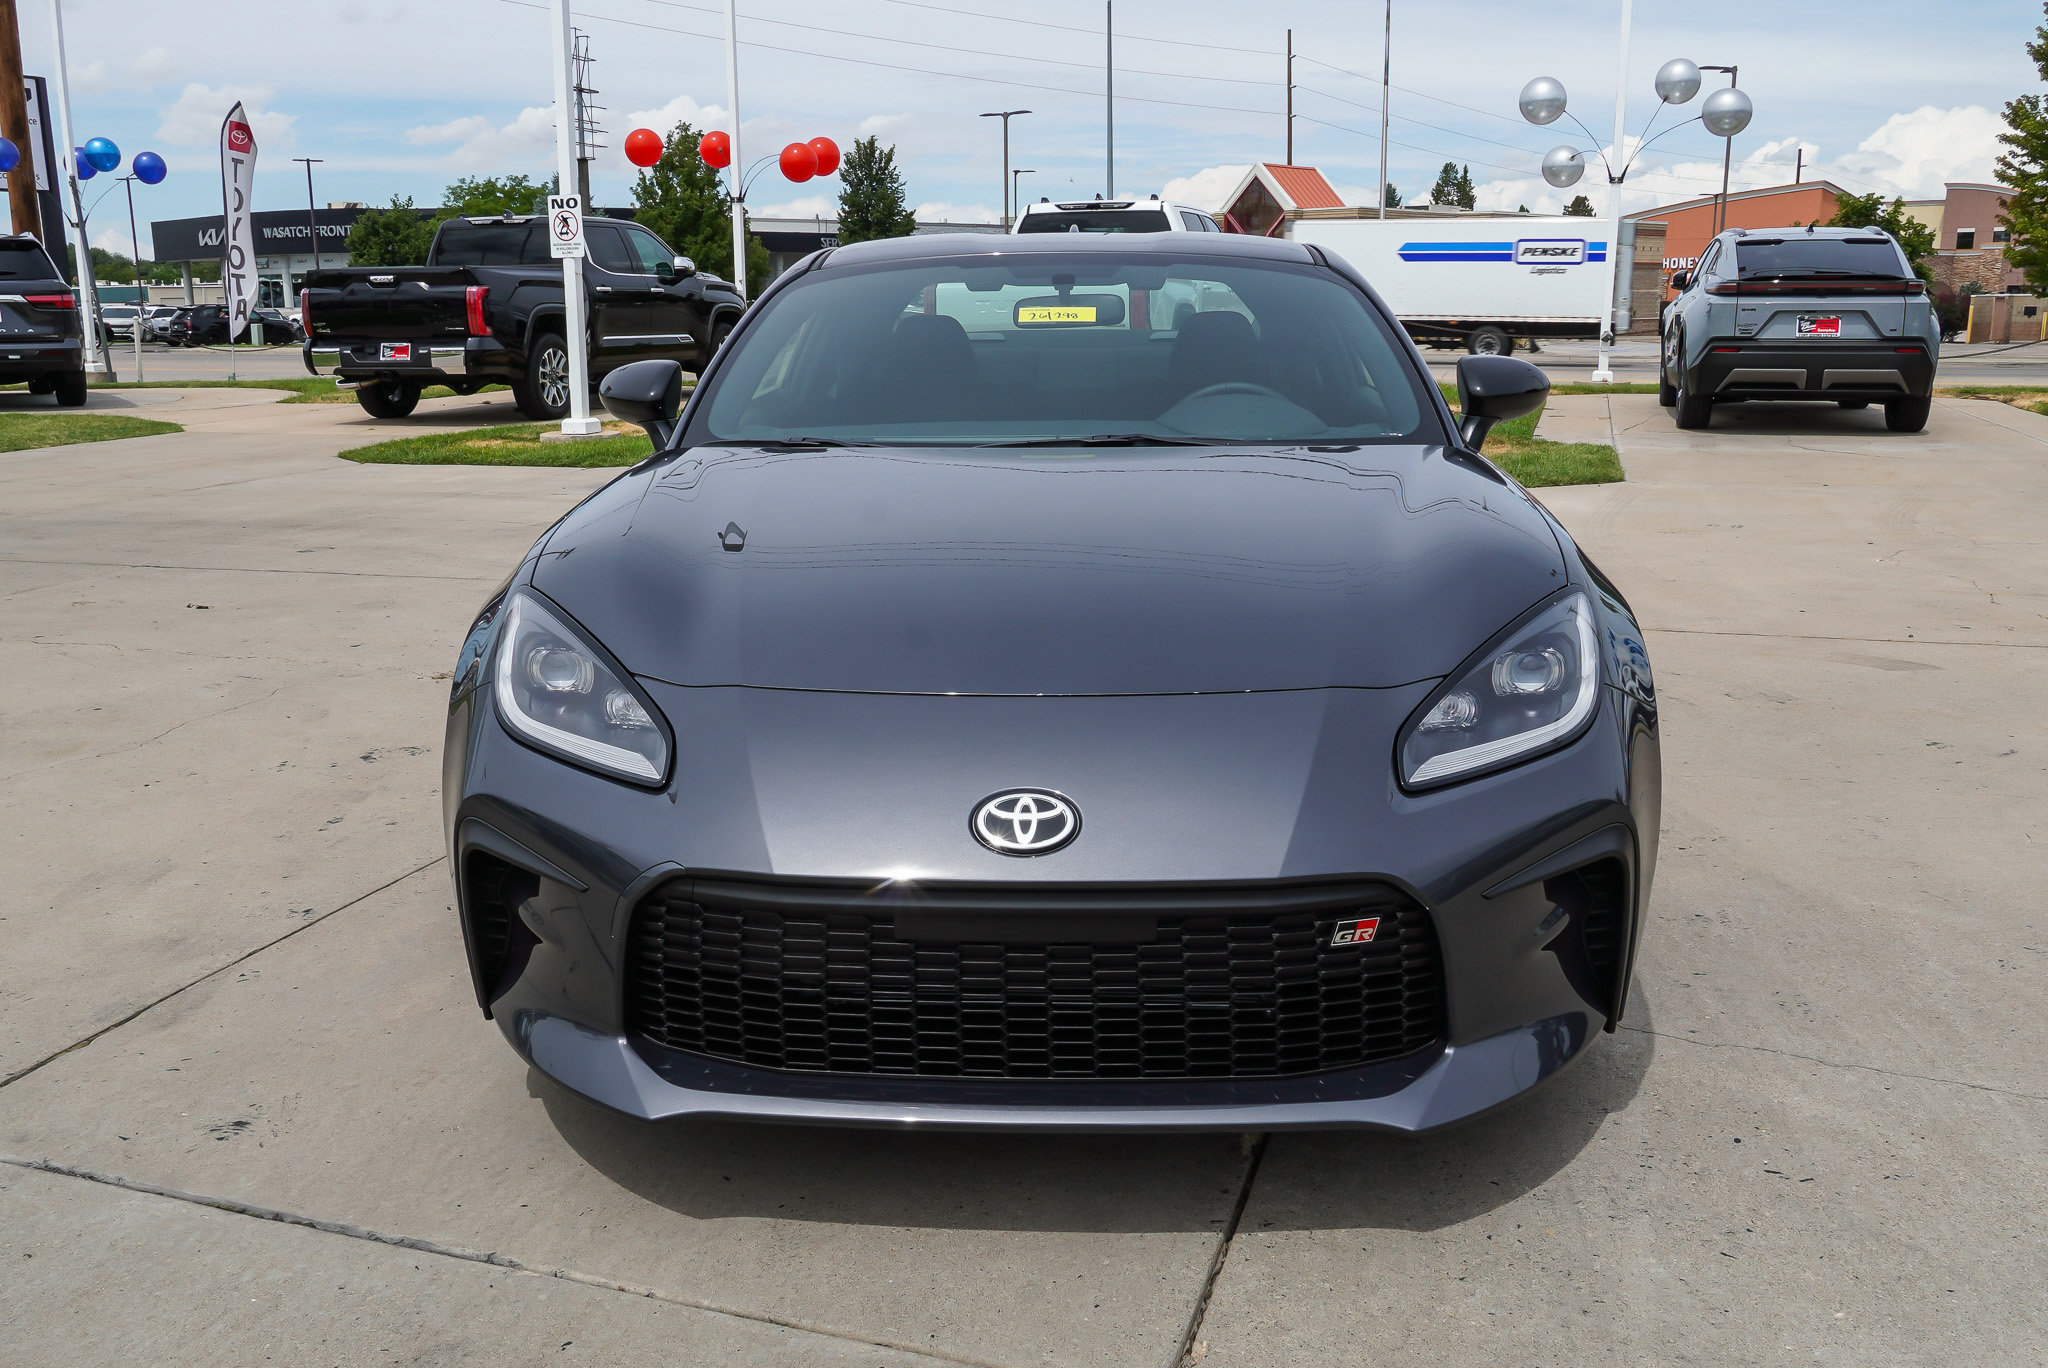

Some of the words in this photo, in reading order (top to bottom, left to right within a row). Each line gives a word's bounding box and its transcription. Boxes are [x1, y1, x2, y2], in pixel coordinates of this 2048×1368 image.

[551, 197, 578, 209] NO
[263, 226, 311, 238] WASATCH
[1521, 248, 1580, 256] PENSKE
[1335, 928, 1373, 942] GR
